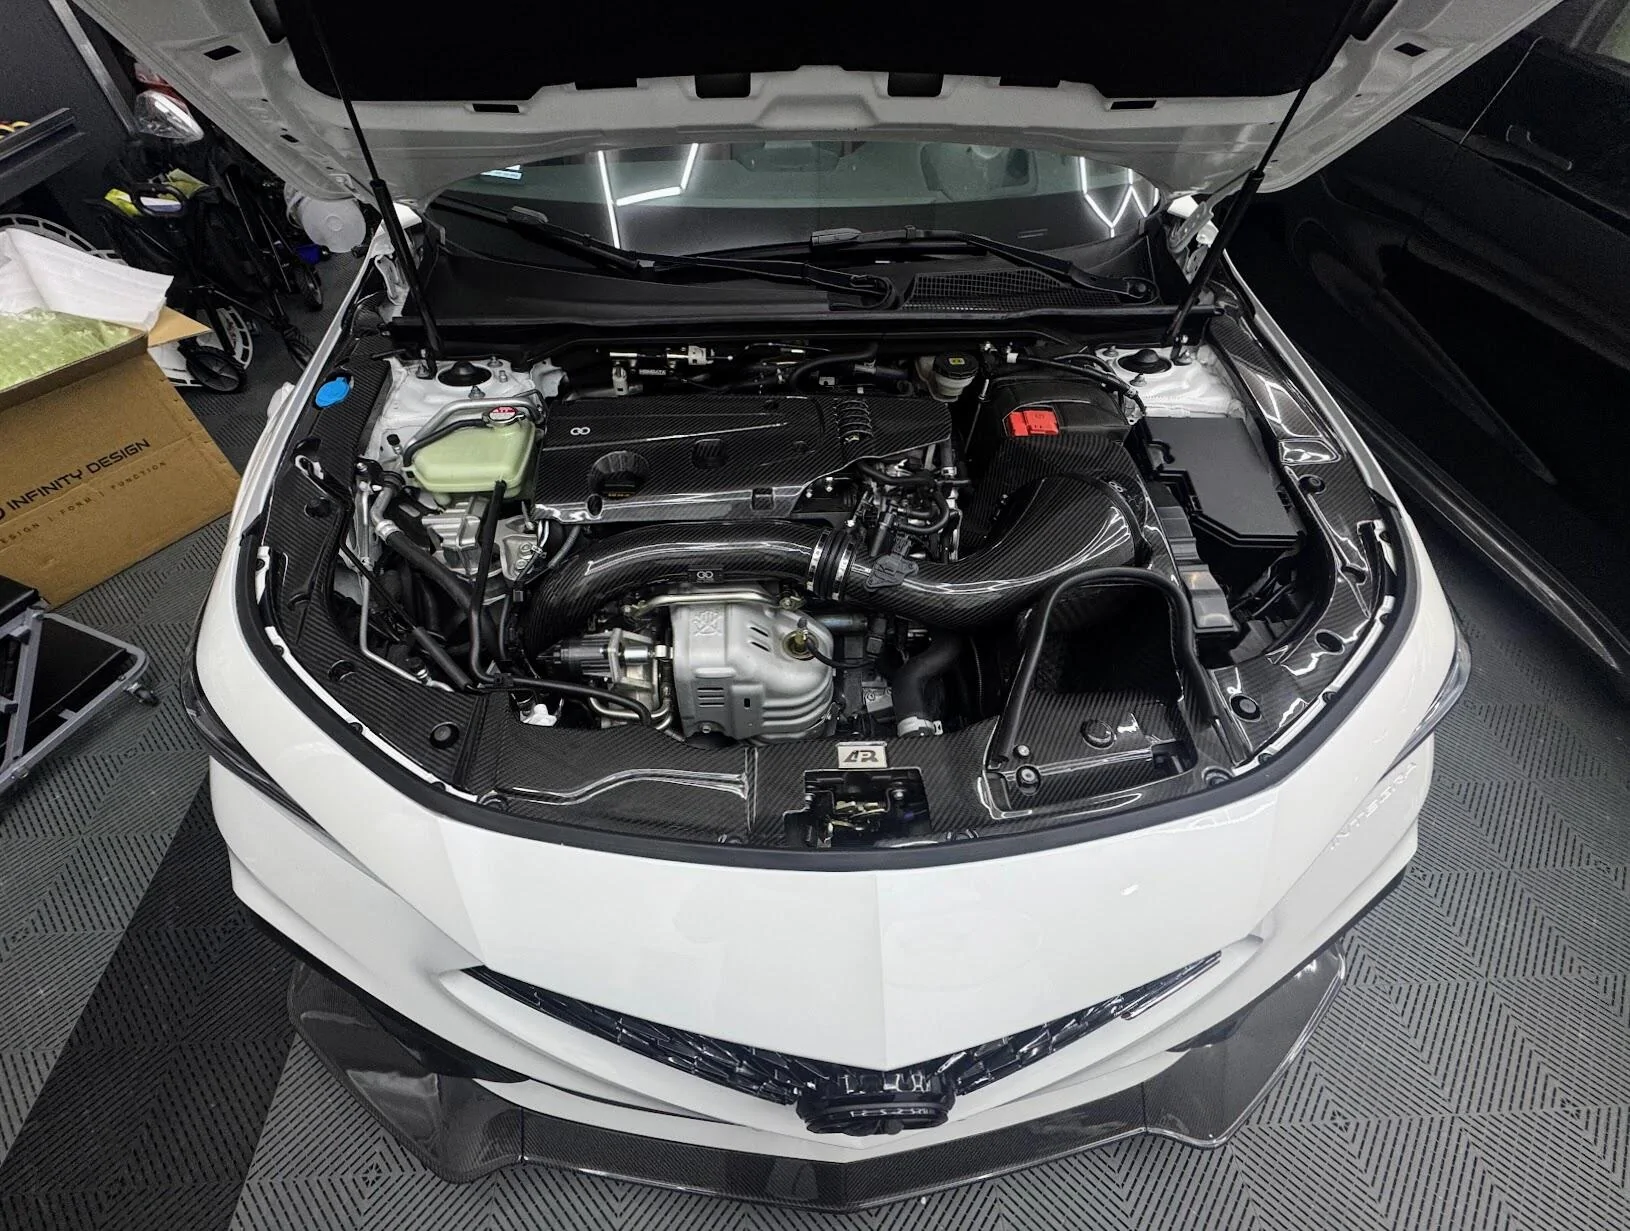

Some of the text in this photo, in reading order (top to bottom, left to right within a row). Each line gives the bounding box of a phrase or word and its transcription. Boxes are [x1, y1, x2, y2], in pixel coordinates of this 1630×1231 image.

[7, 438, 151, 511] INFINITY DESIGN
[60, 497, 92, 515] FORM
[110, 461, 167, 490] FUNCTION
